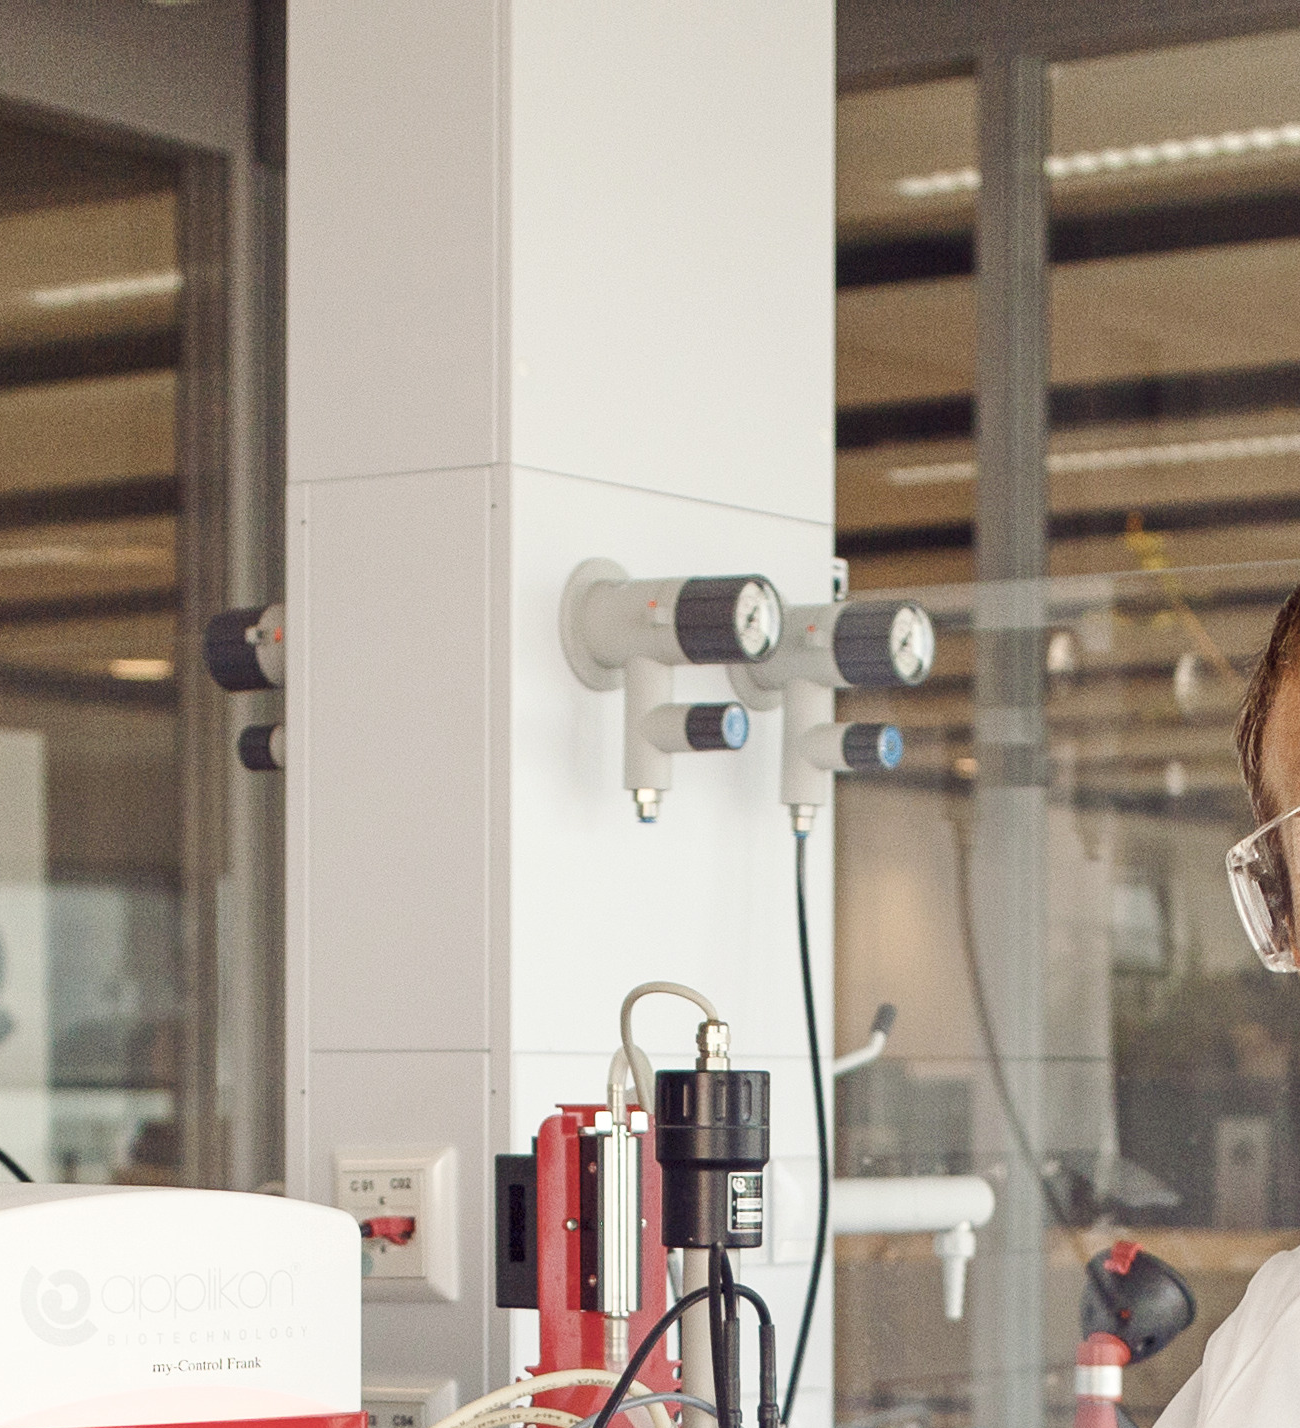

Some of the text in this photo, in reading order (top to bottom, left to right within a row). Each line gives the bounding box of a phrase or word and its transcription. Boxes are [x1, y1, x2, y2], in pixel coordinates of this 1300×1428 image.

[107, 1325, 309, 1346] BIOTECHNOLOGY
[152, 1356, 262, 1376] my-Control Frank
